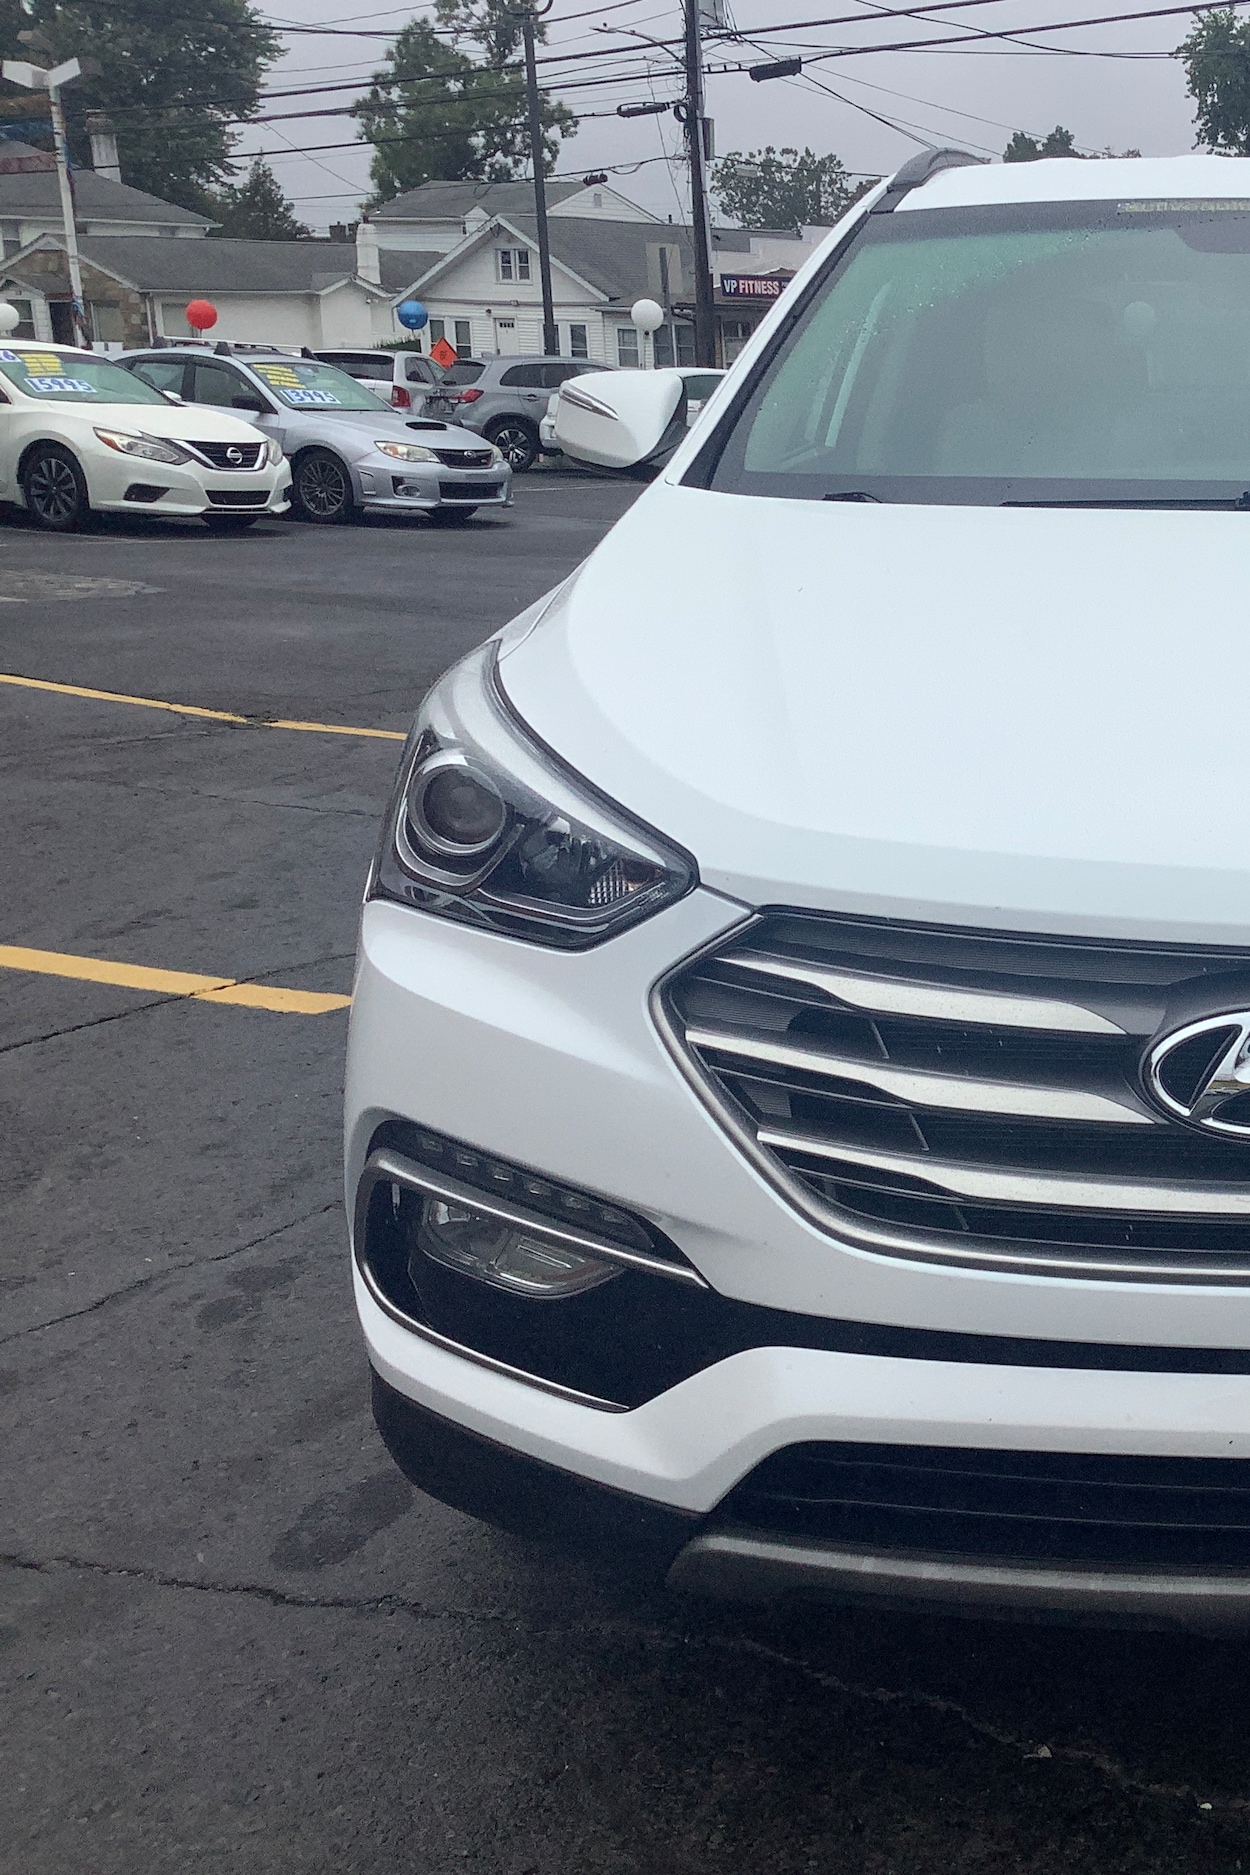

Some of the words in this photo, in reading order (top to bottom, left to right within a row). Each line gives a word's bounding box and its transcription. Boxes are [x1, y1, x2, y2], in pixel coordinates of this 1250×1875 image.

[723, 279, 737, 293] VP
[739, 280, 780, 295] FITNESS
[27, 378, 93, 391] 15995
[282, 390, 337, 402] 13995
